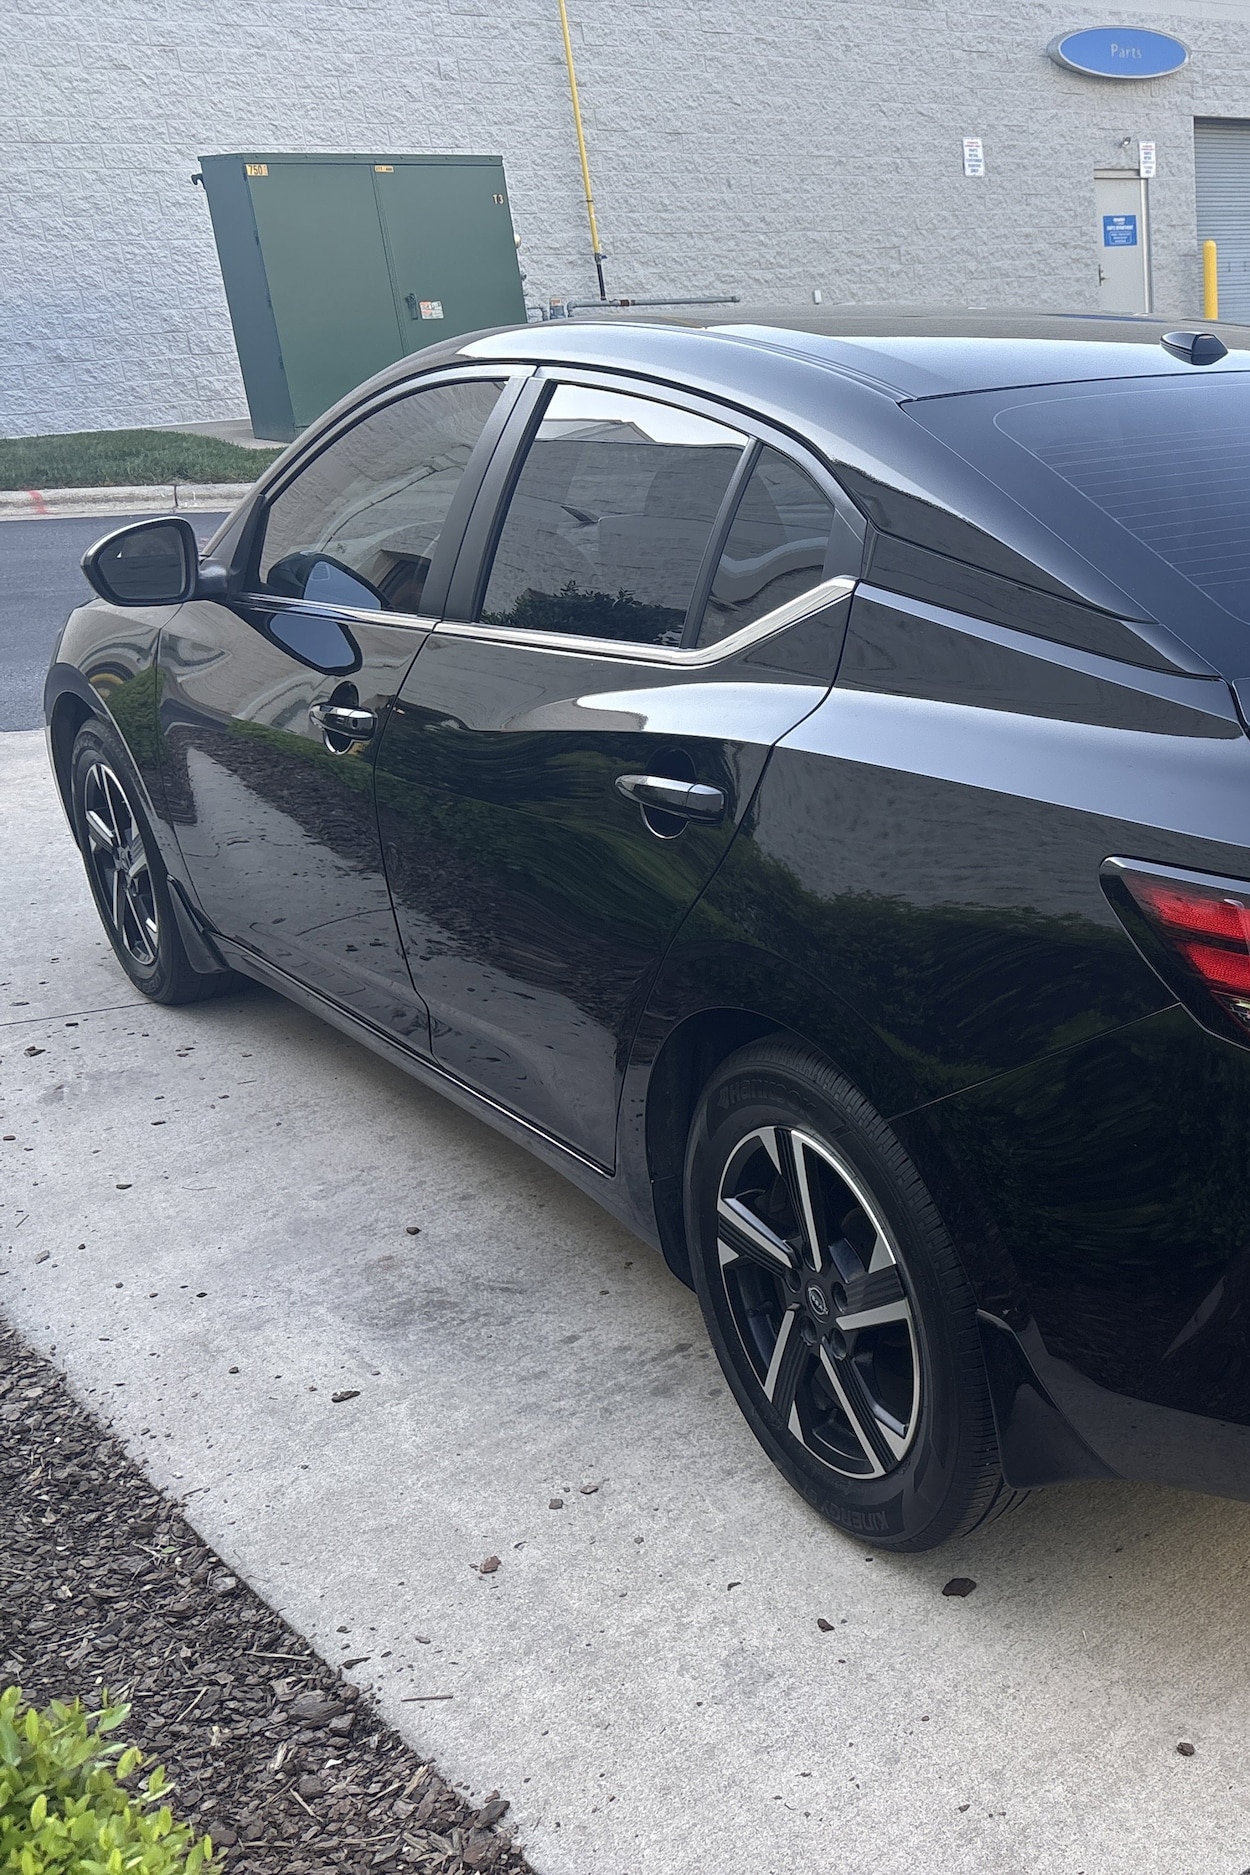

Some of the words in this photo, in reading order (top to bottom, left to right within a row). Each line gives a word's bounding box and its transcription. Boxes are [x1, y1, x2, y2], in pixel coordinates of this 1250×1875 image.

[1110, 43, 1143, 60] Parts
[248, 164, 263, 175] 750
[492, 193, 504, 205] T3
